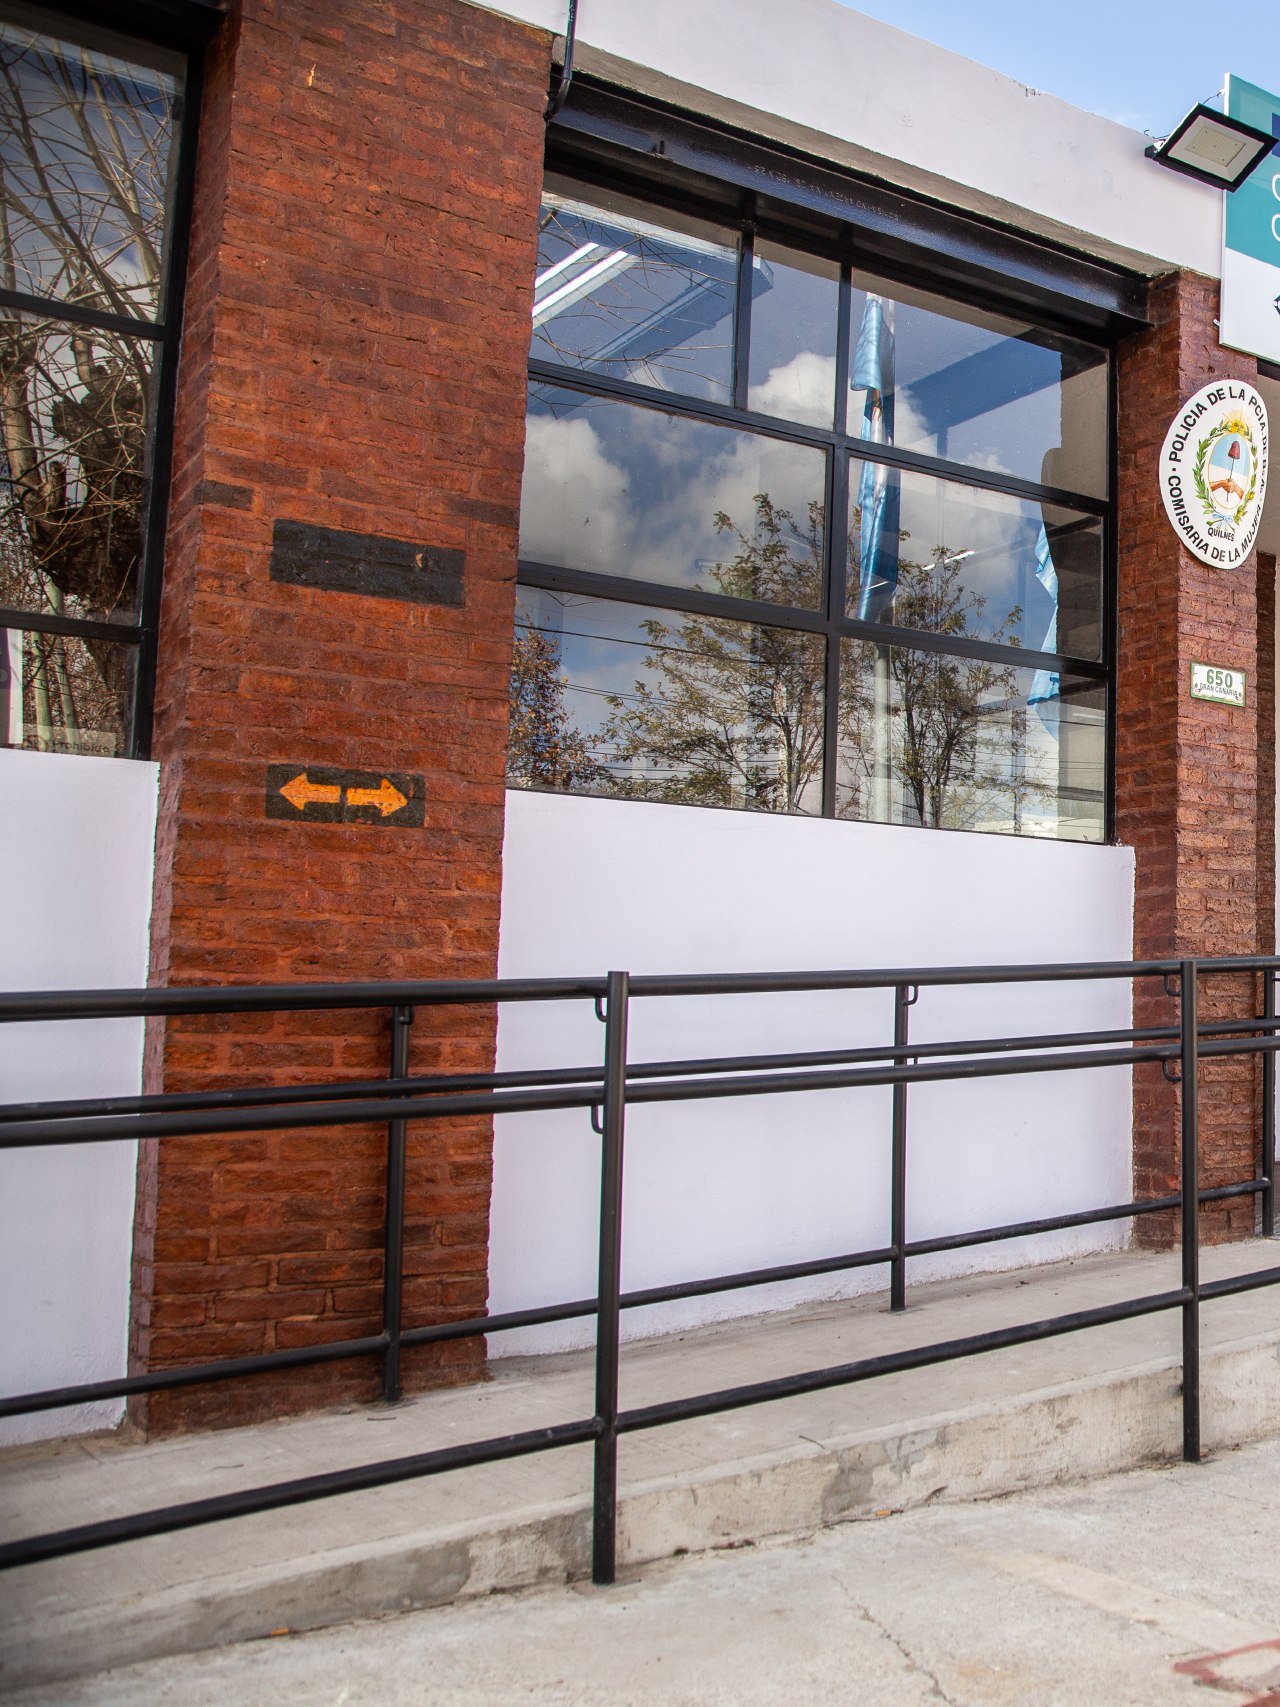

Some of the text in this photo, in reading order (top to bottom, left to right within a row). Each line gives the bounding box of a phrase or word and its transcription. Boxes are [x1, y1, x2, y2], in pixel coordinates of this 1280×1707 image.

[1168, 402, 1208, 463] POLICIA
[1206, 387, 1226, 406] DE
[1228, 386, 1245, 401] LA
[1168, 475, 1261, 562] COMISARIA DE LA MUJER
[1207, 527, 1235, 542] QUILMES
[1206, 669, 1233, 688] 650
[1200, 683, 1238, 696] GRAN CANARIA
